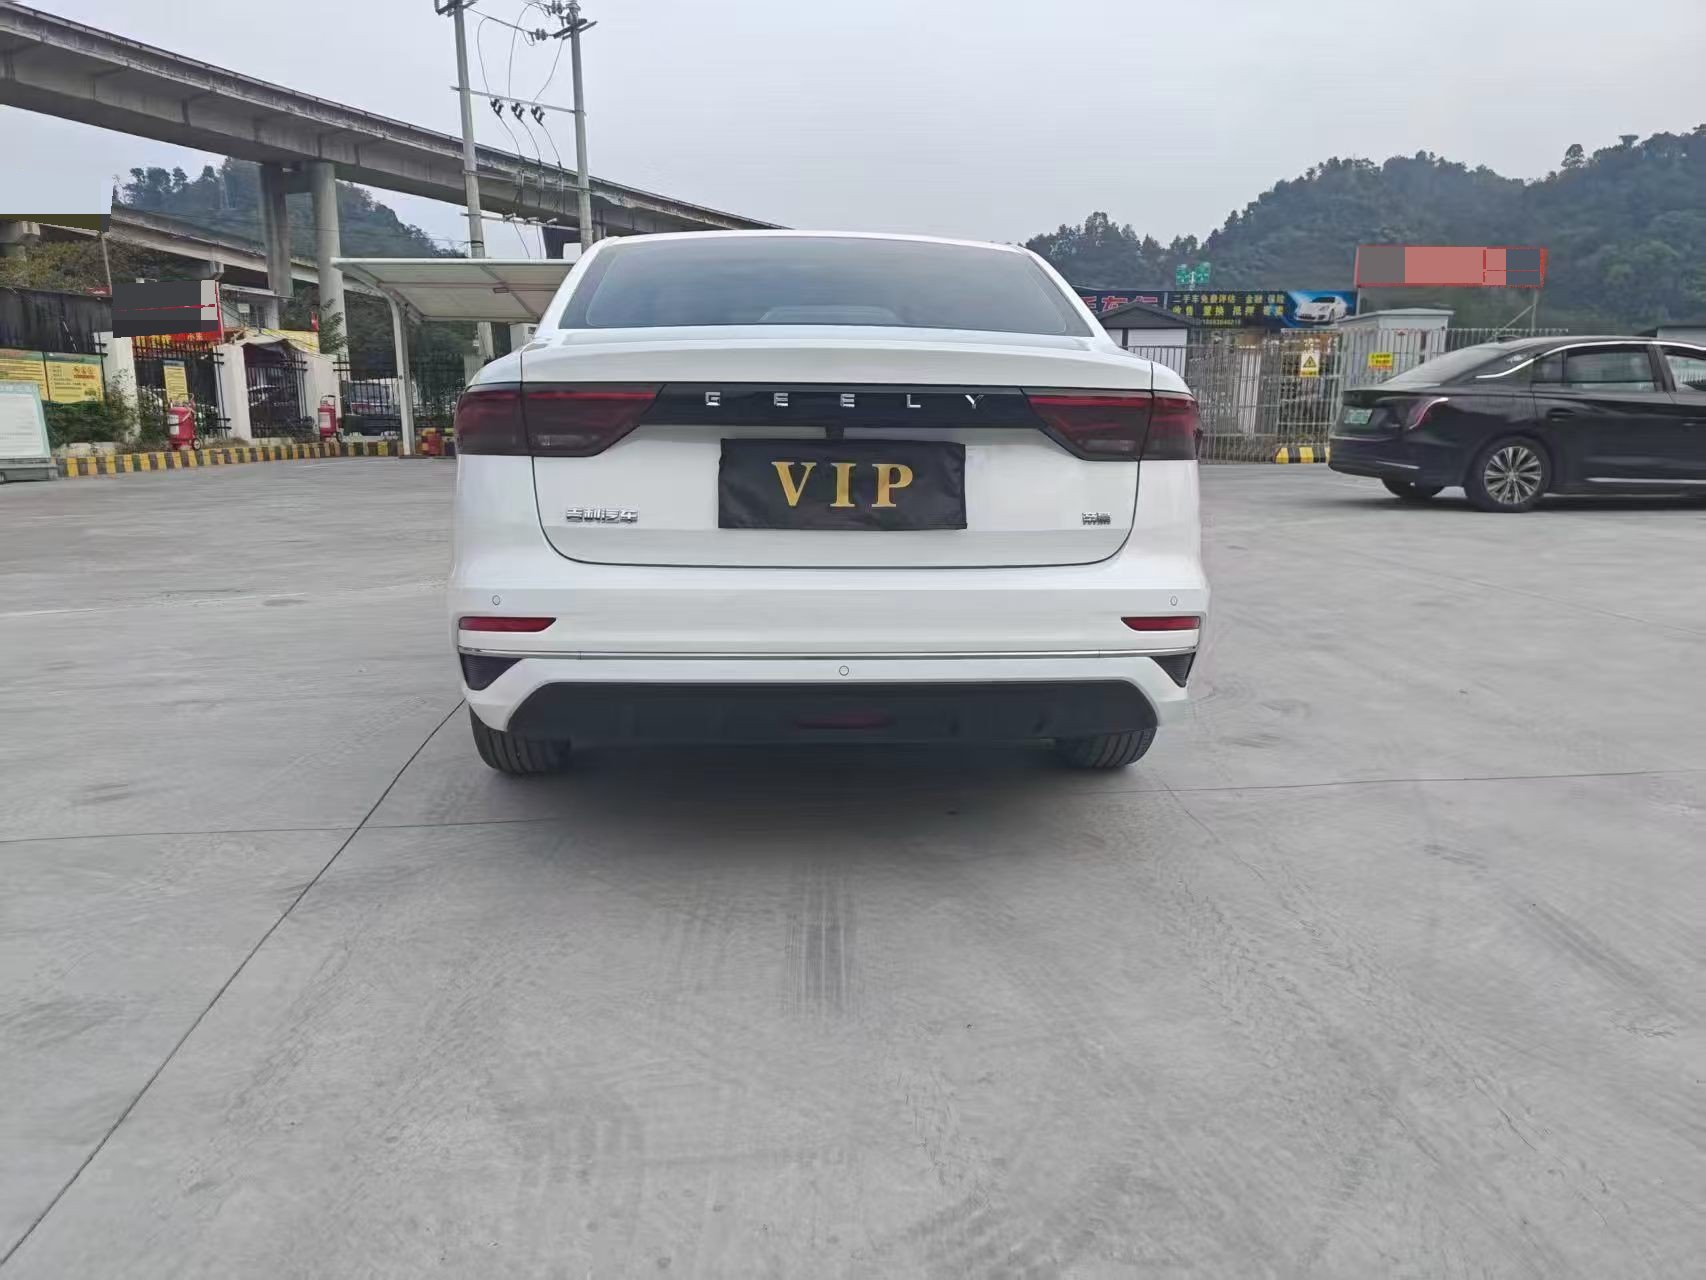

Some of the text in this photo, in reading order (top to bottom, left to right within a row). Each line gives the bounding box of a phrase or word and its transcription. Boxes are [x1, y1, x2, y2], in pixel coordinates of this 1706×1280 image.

[705, 391, 985, 409] GEELY
[771, 461, 914, 508] VIP
[566, 508, 638, 524] 吉利汽车
